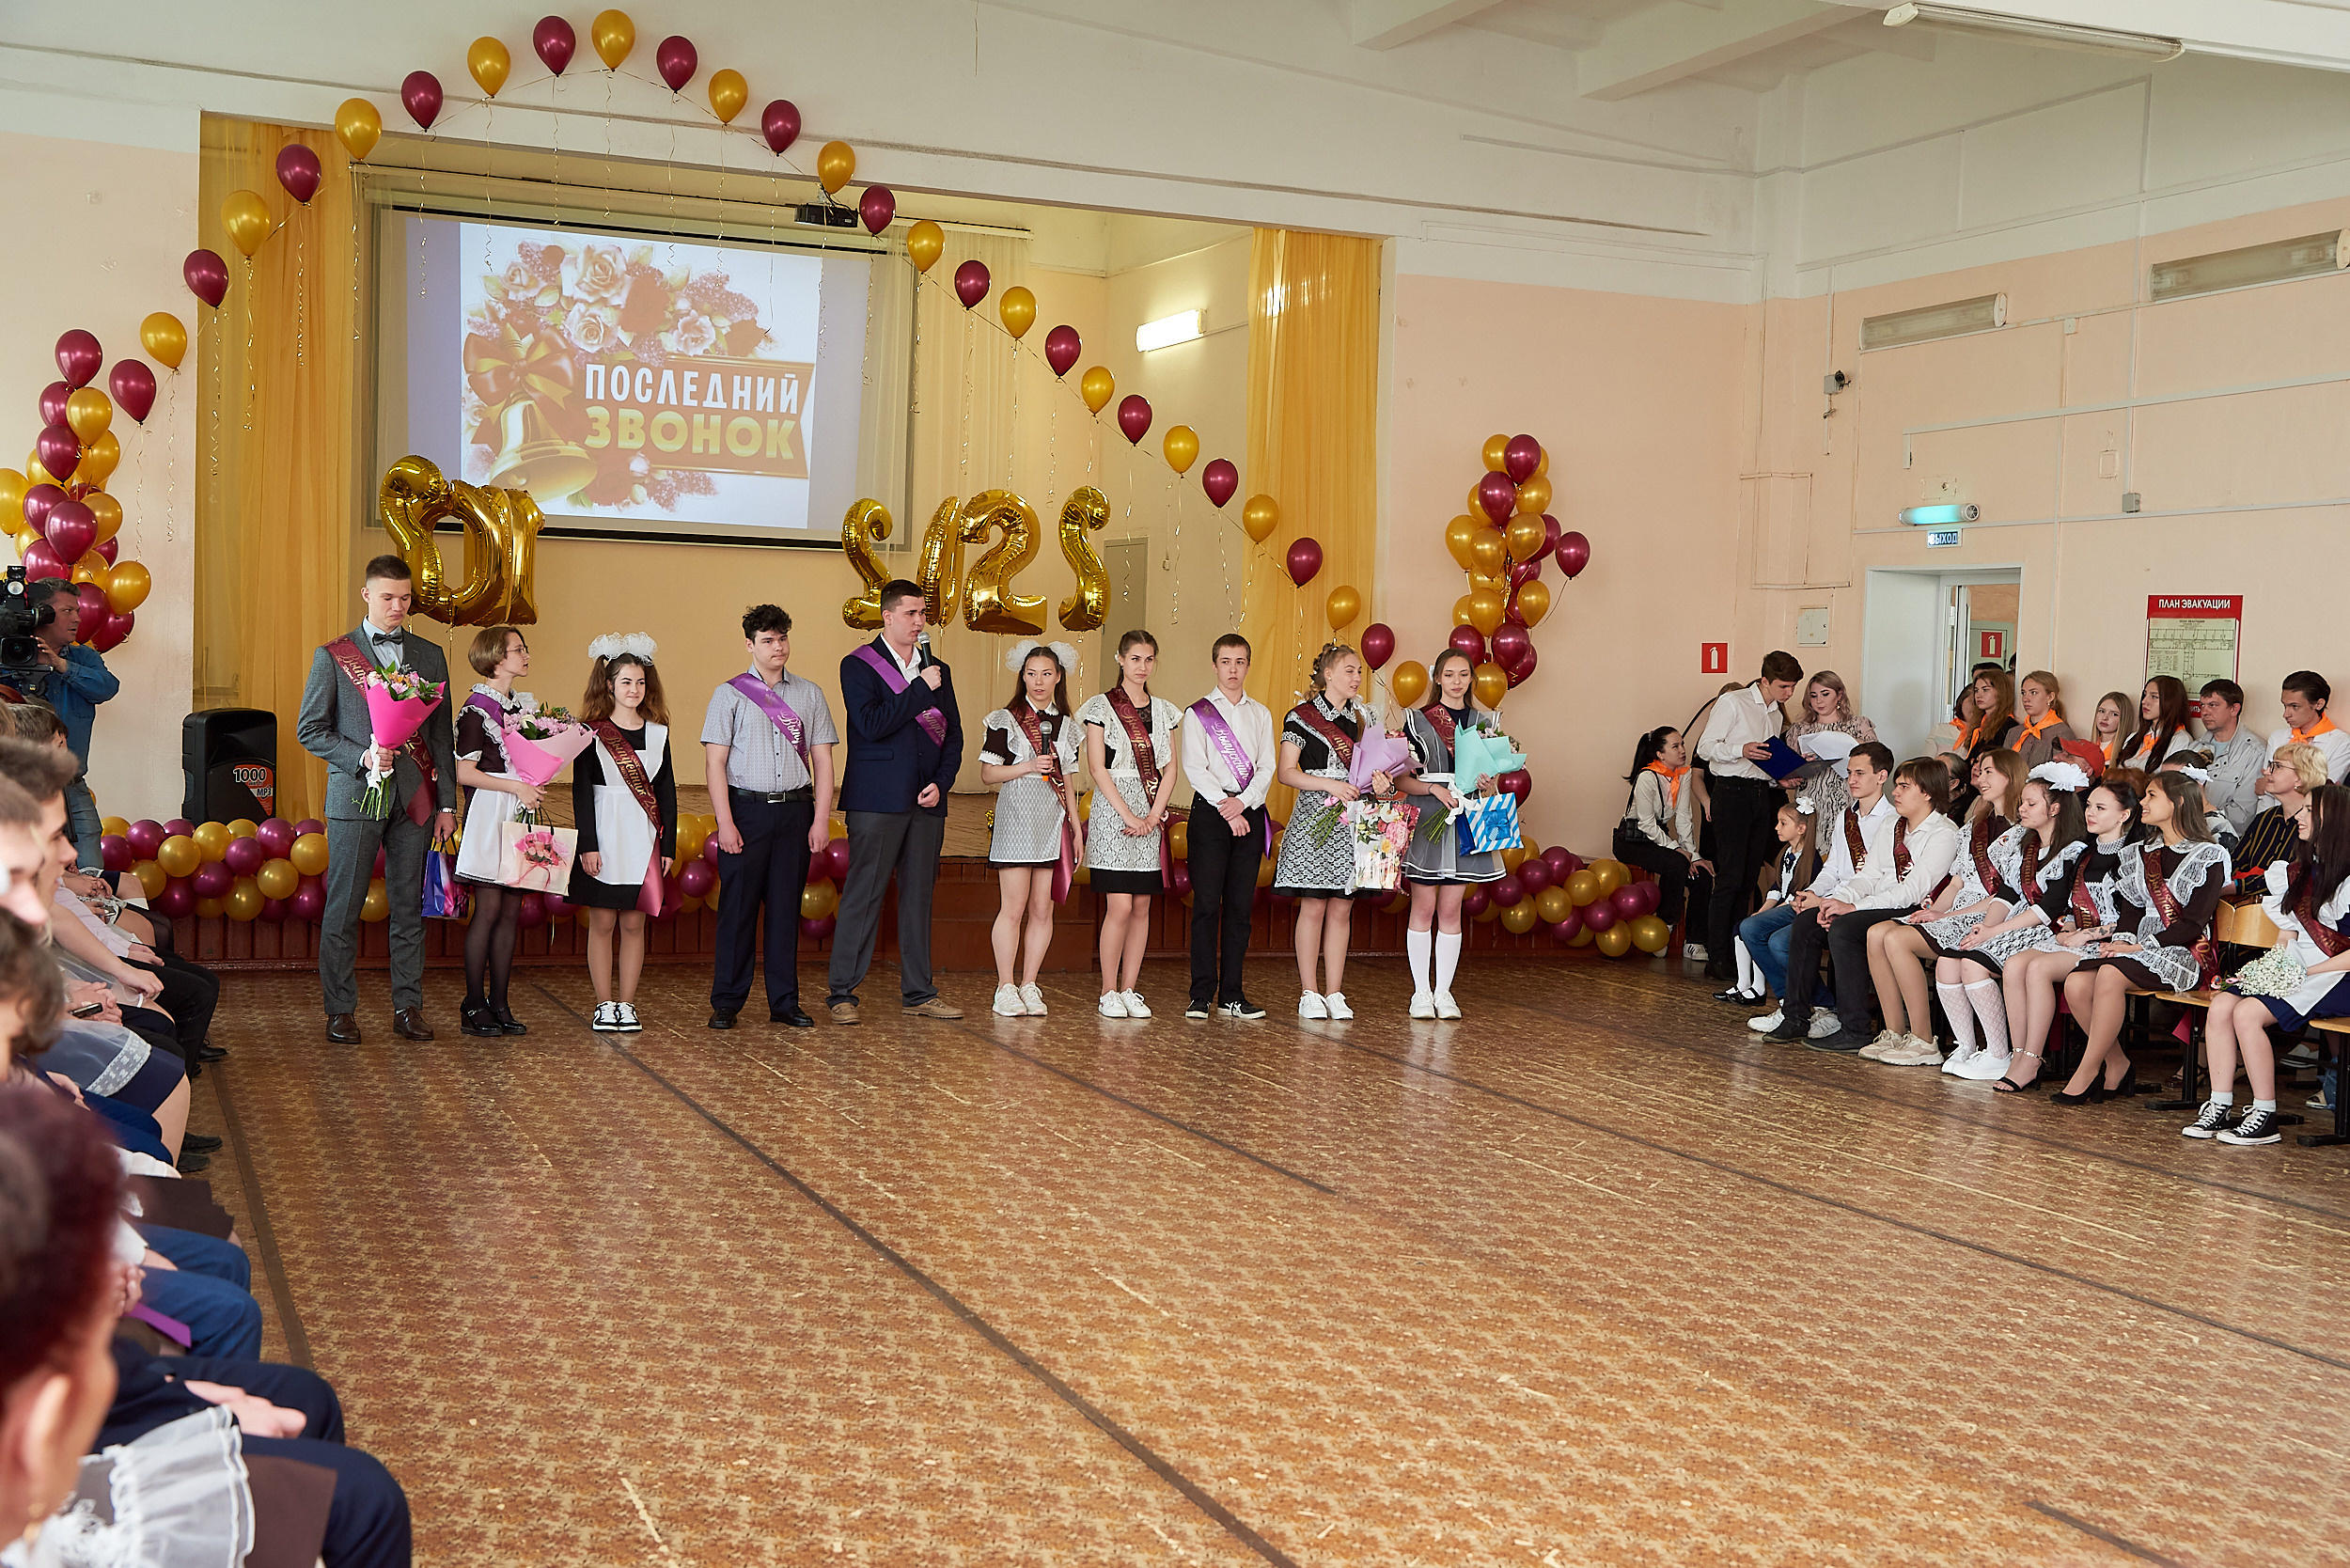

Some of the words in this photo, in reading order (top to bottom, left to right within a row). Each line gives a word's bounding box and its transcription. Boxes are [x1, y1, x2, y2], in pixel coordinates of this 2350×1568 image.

[586, 364, 799, 415] ПОСЛЕДНИЙ
[584, 406, 796, 461] ЗВОНОК
[1929, 532, 1958, 545] ВЫХОД
[2158, 599, 2180, 608] ПЛАН
[2181, 599, 2231, 610] ЭВАКУАЦИИ
[1211, 720, 1250, 780] Выпускник
[233, 767, 267, 783] 1000
[257, 788, 272, 798] MP3
